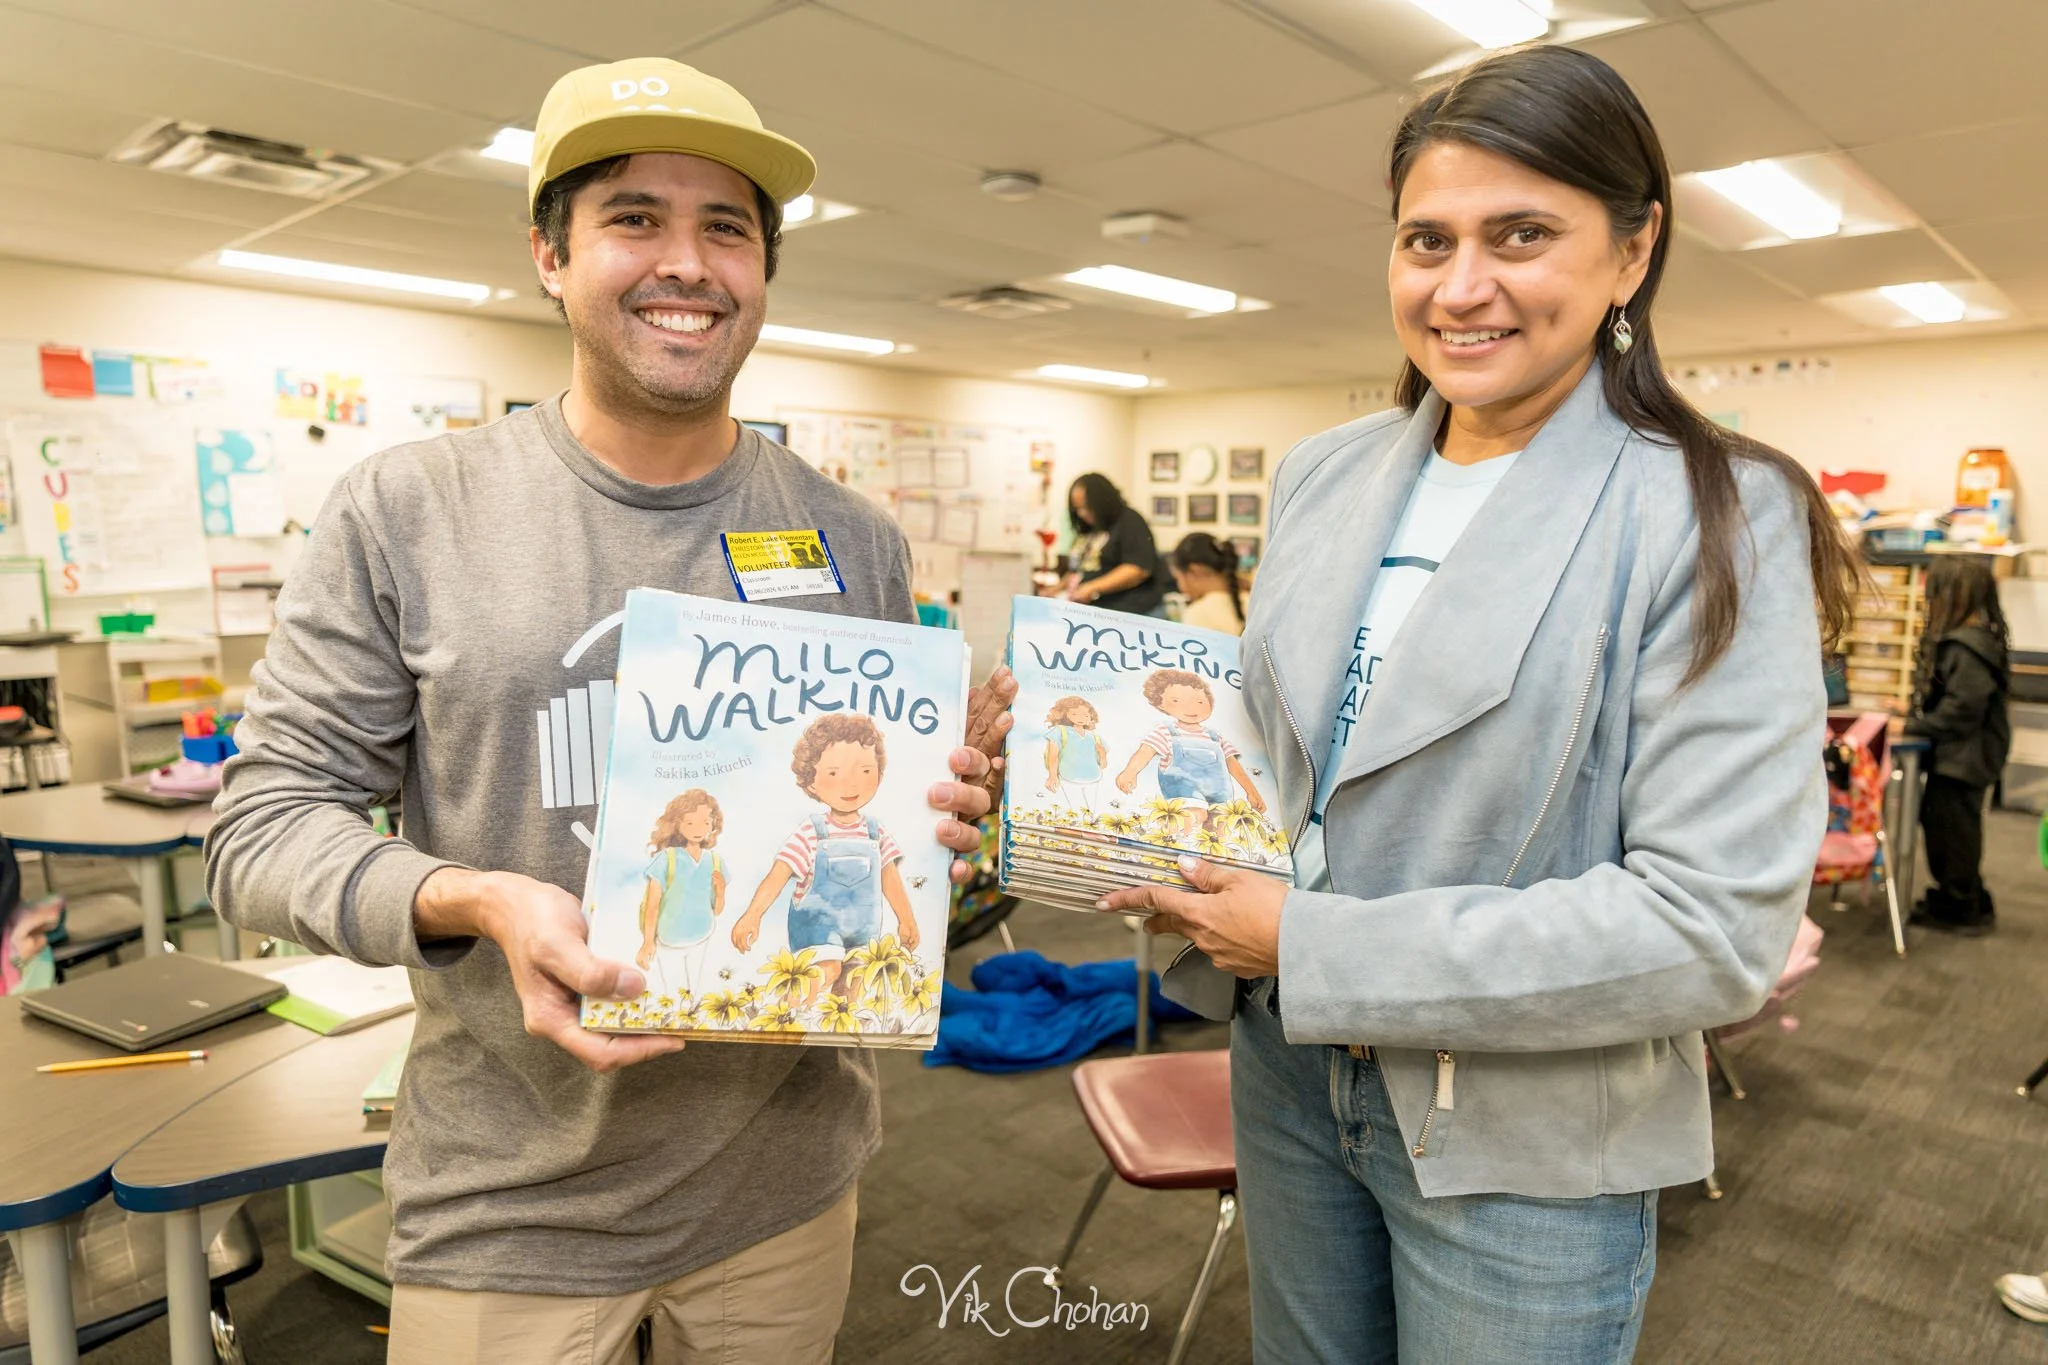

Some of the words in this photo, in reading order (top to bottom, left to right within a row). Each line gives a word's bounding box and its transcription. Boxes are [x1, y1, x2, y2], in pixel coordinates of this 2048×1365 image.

[610, 77, 670, 101] DO
[729, 536, 753, 545] Robert
[753, 536, 761, 544] E.
[761, 535, 778, 543] Lake
[779, 534, 815, 542] Elementary
[737, 561, 792, 573] VOLUNTEER
[682, 609, 695, 621] By
[696, 609, 738, 625] James
[741, 613, 781, 631] Howe,
[782, 622, 829, 638] bestselling
[829, 628, 858, 640] author
[858, 631, 869, 641] of
[869, 632, 913, 646] Bunnicula
[1062, 617, 1207, 656] MILO
[694, 633, 894, 690] MILO
[1027, 640, 1243, 691] WALKING
[638, 678, 939, 744] WALKING
[651, 750, 703, 762] Illustrated
[705, 749, 716, 759] by
[655, 767, 699, 779] Sakika
[703, 755, 752, 777] Kikuchi
